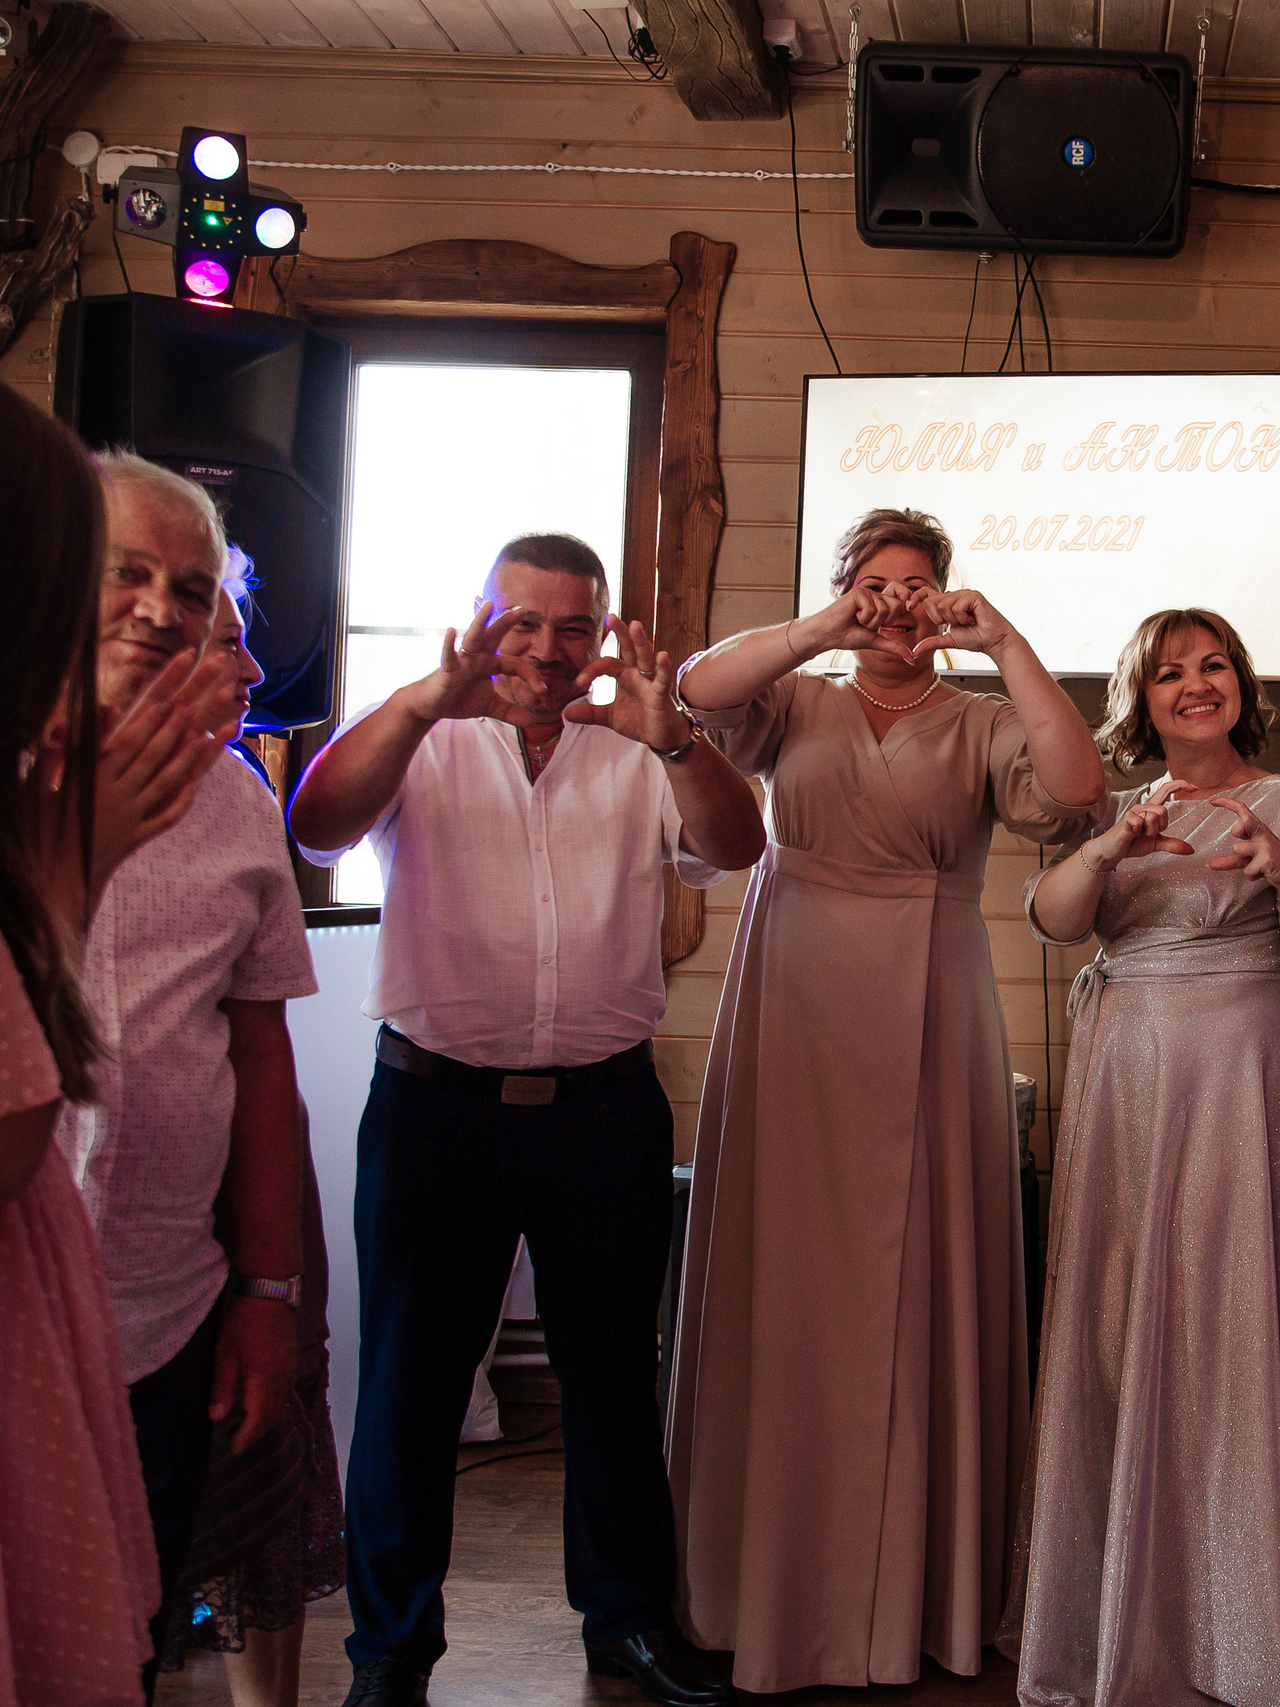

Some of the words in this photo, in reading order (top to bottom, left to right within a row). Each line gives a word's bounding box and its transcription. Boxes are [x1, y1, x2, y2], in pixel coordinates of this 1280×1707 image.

[1072, 141, 1084, 165] RCF
[840, 422, 1018, 474] ЮЛИЯ
[190, 466, 207, 474] ART
[969, 514, 1146, 552] 20.07.2021
